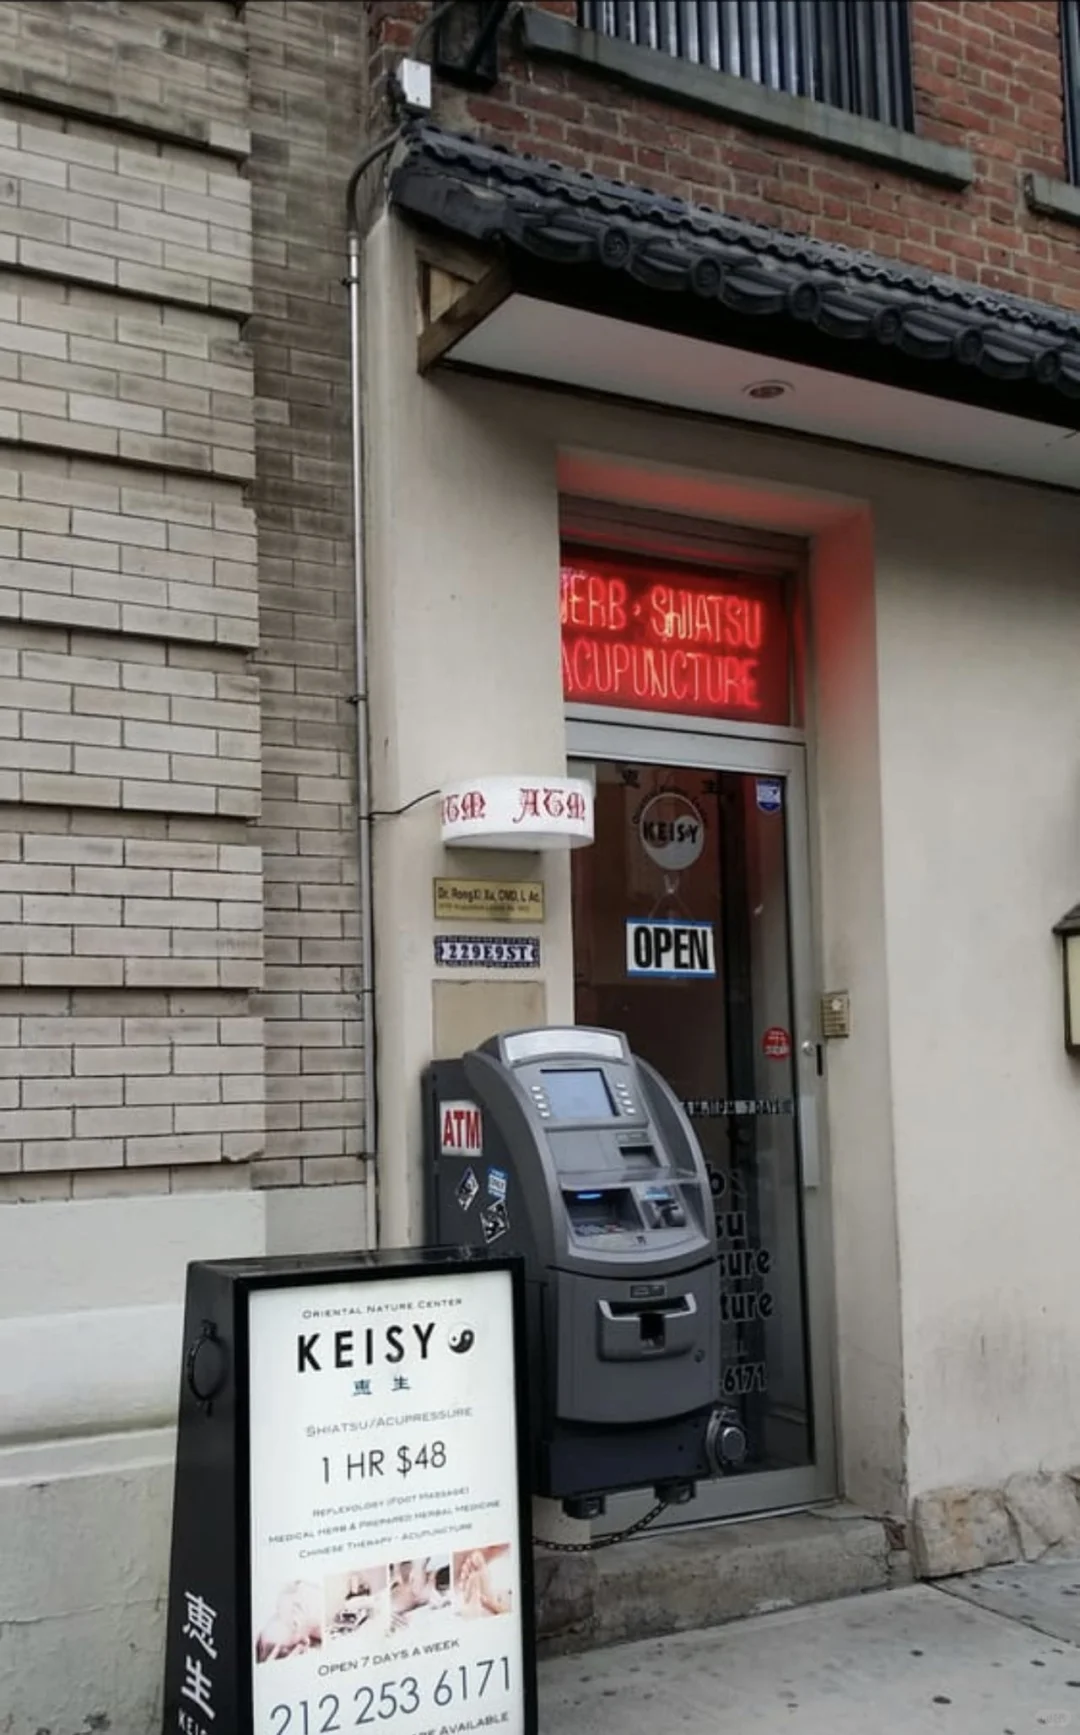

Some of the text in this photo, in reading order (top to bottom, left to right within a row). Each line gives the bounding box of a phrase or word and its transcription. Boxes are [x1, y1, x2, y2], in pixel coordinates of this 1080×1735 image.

[651, 585, 763, 649] SHIATSU
[441, 788, 586, 824] TM ATM
[643, 822, 700, 843] KEISY
[633, 925, 709, 970] OPEN
[443, 1110, 481, 1149] ATM
[297, 1322, 436, 1374] KEISY
[322, 1440, 447, 1485] 1 HR $48
[318, 1658, 359, 1677] OPEN
[361, 1656, 371, 1669] 7
[373, 1649, 410, 1667] DAYS
[423, 1638, 461, 1655] WEEK
[270, 1656, 511, 1735] 212 253 6171
[439, 1711, 510, 1735] AVAILABLE
